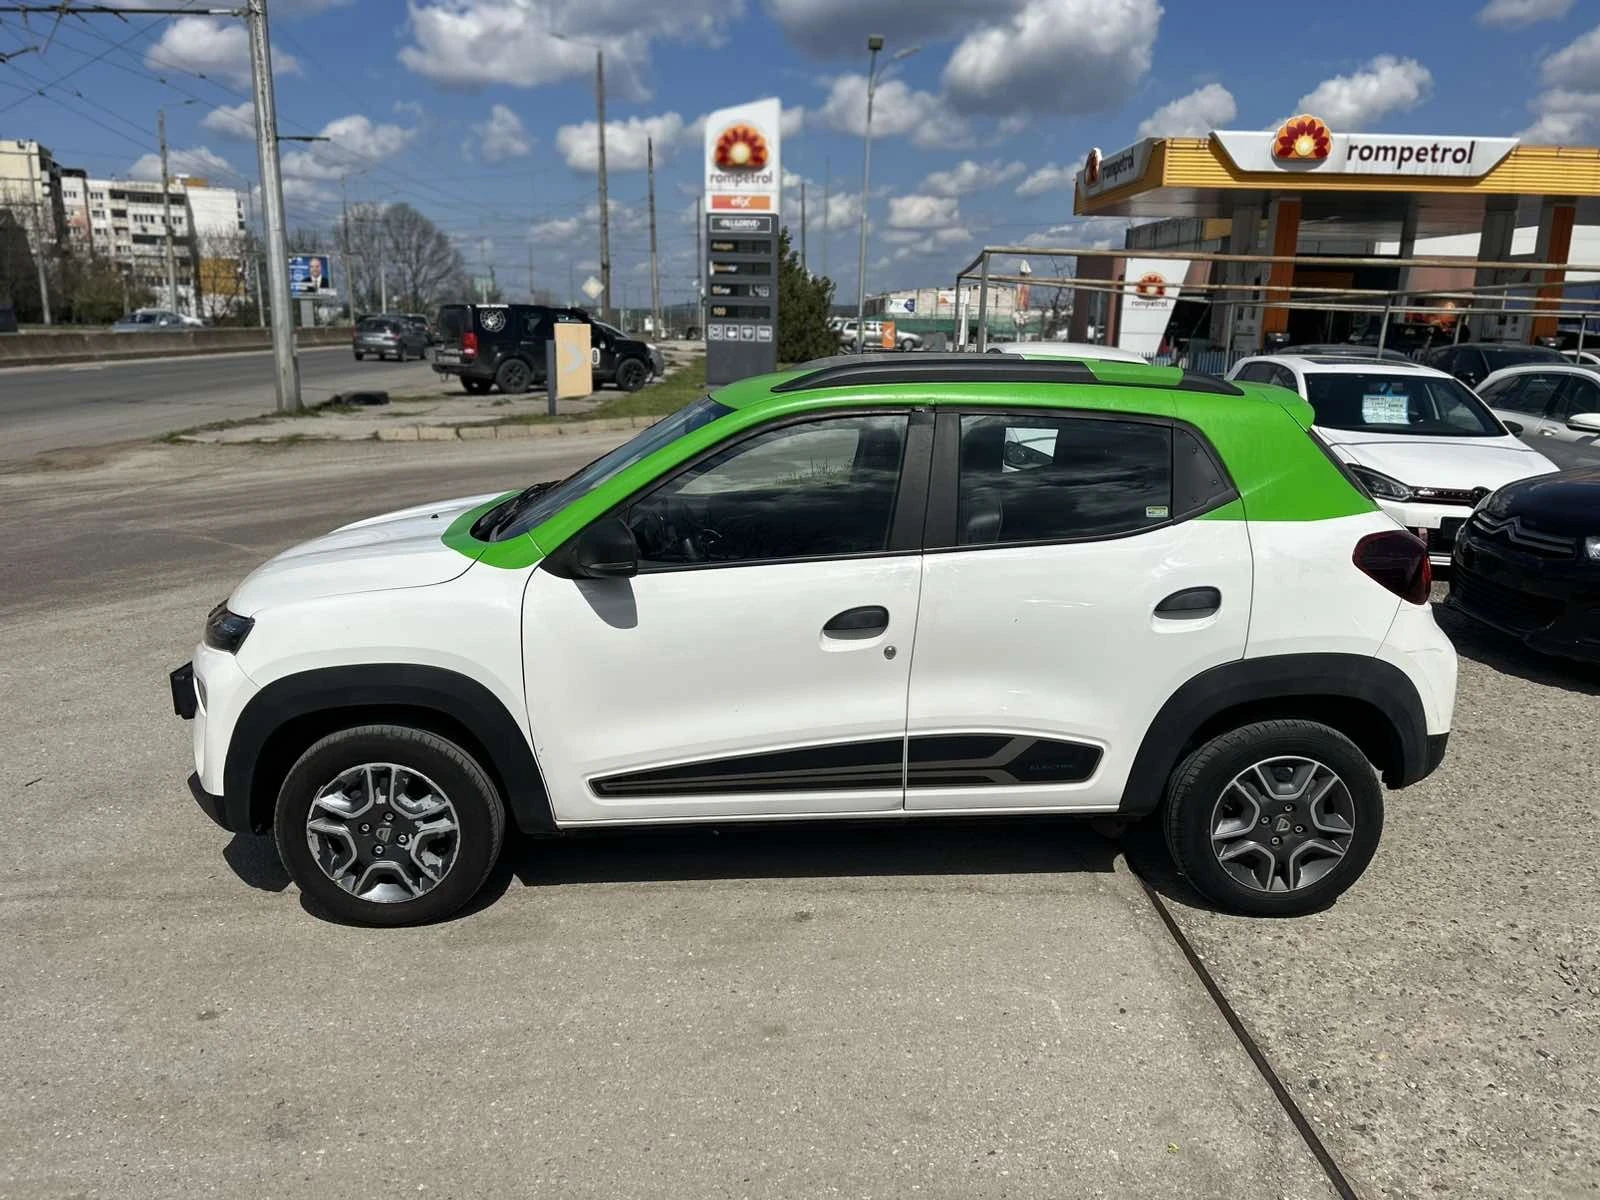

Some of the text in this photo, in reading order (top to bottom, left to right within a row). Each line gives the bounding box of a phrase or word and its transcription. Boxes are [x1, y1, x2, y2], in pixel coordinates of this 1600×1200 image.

[1102, 146, 1135, 182] rompetrol
[1345, 140, 1475, 170] rompetrol
[709, 171, 773, 187] rompetrol
[1131, 301, 1168, 309] rompetrol
